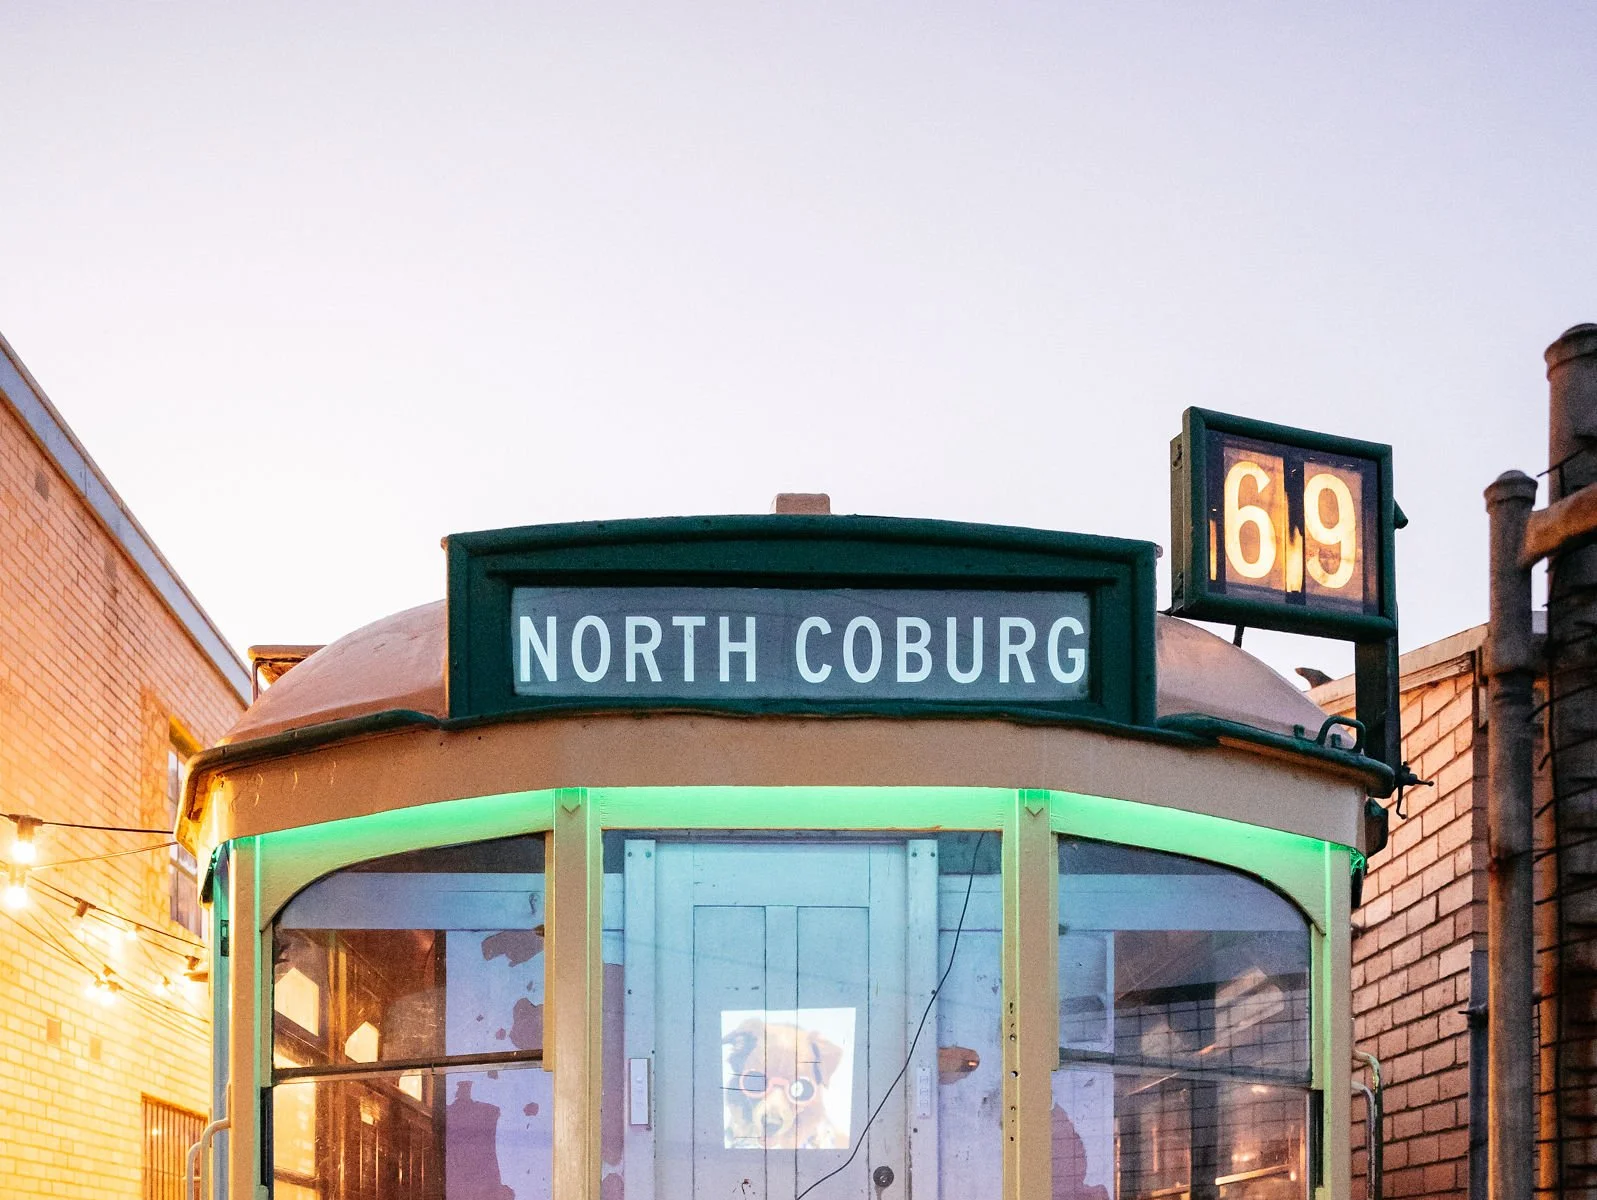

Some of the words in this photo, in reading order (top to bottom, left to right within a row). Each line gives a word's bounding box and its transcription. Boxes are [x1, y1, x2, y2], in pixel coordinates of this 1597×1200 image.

[1223, 461, 1356, 589] 69
[519, 615, 756, 683] NORTH
[796, 615, 1086, 684] COBURG
